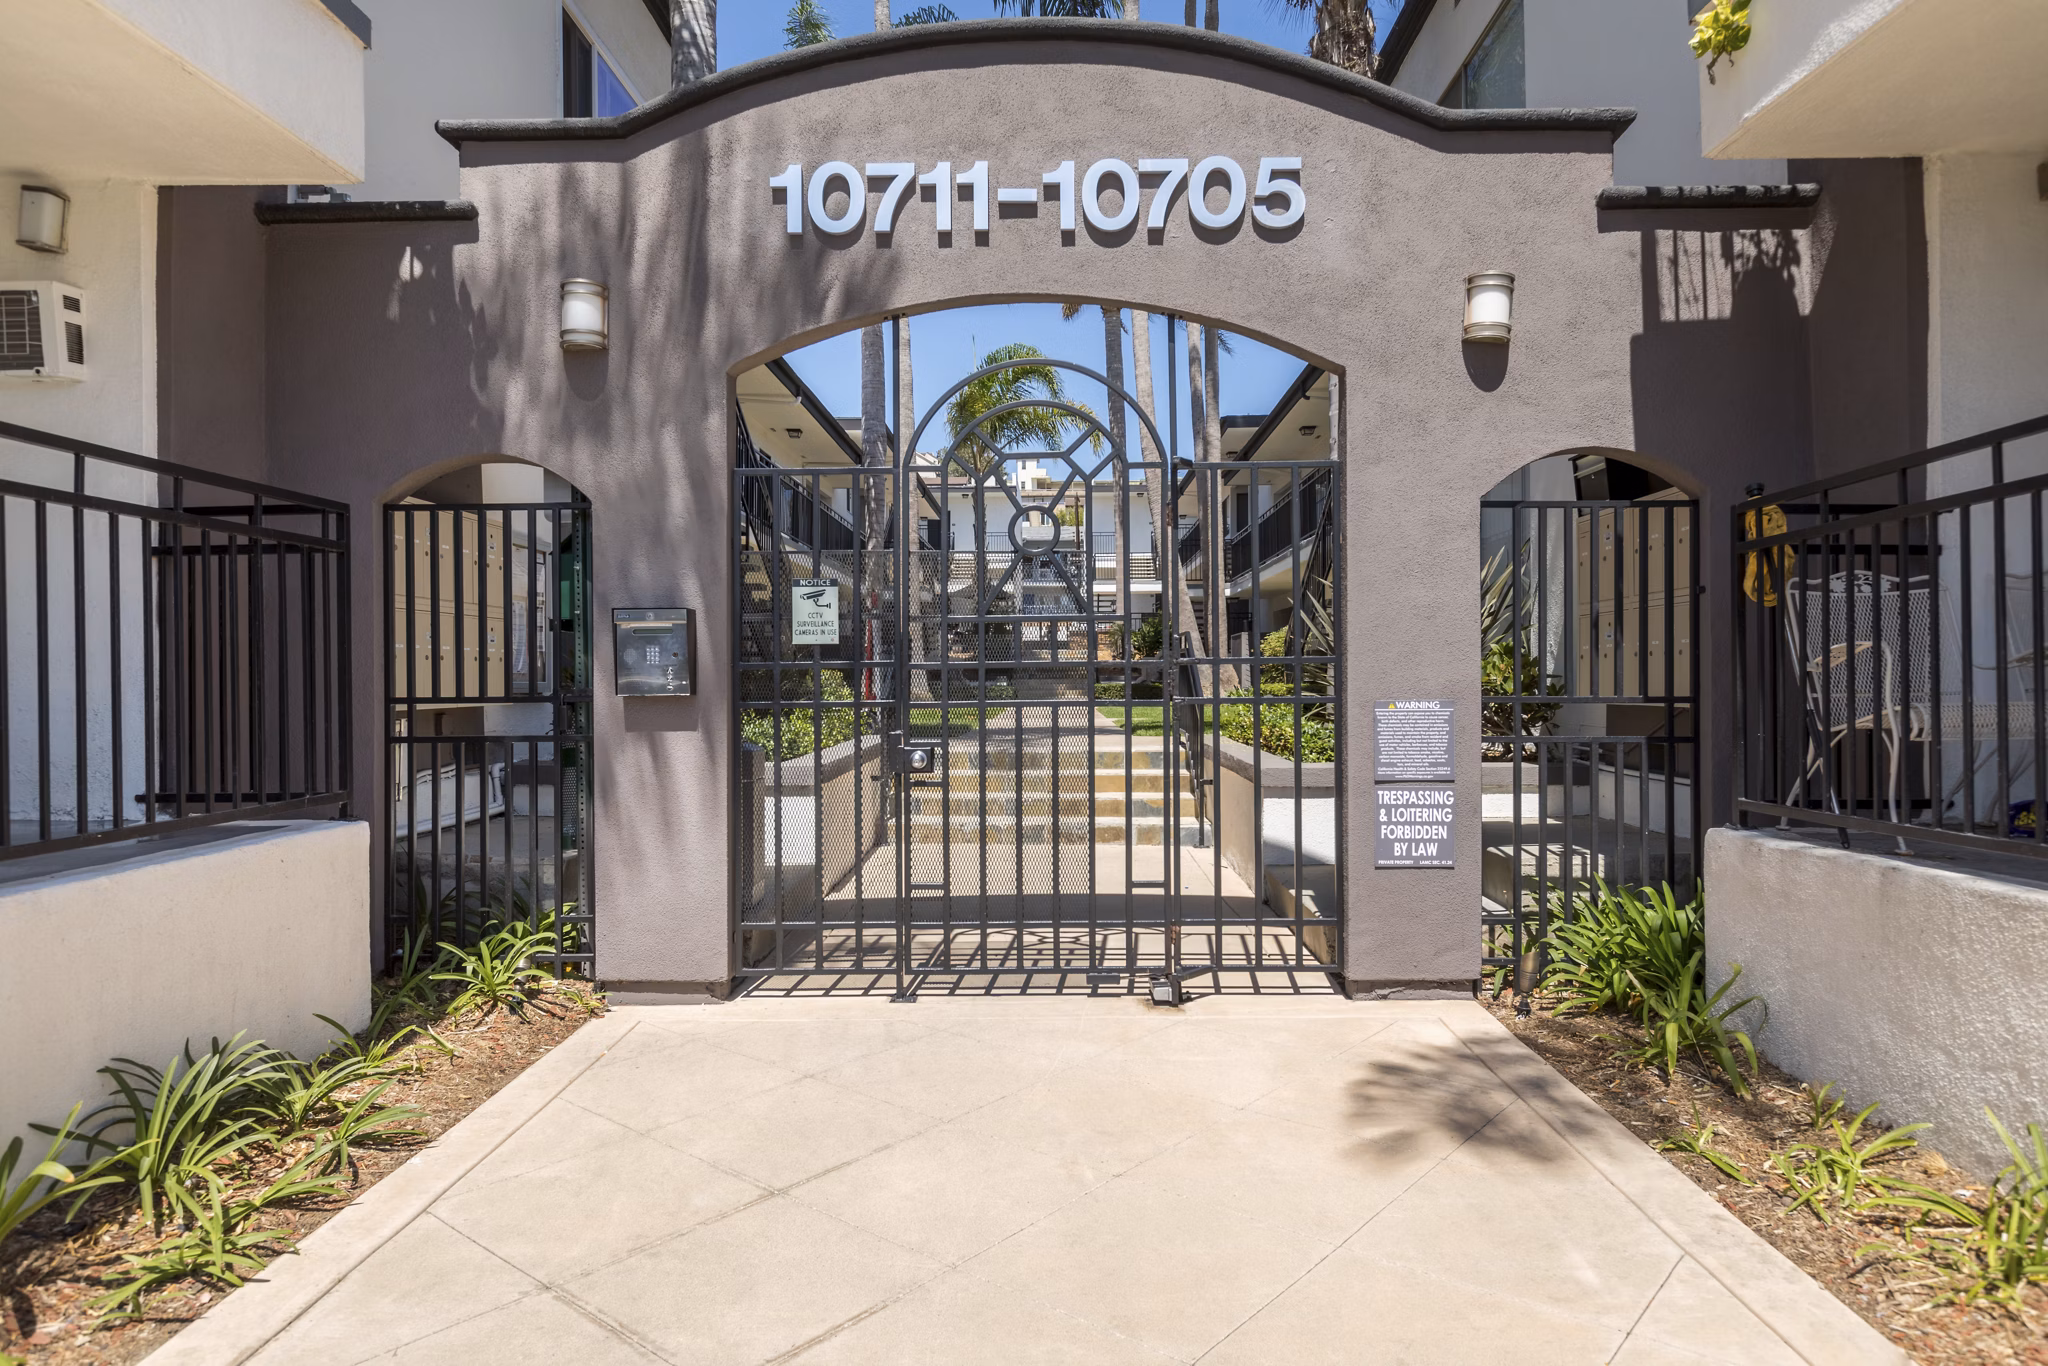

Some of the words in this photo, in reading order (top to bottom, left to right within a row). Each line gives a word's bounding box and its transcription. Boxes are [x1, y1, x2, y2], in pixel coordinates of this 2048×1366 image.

[769, 155, 1306, 235] 10711-10705
[796, 620, 835, 628] SURVEILLANCE
[1395, 700, 1441, 709] WARNING
[1377, 790, 1455, 805] TRESPASSING
[1379, 808, 1388, 822] &
[1391, 807, 1453, 822] LOITERING
[1381, 824, 1448, 839] FORBIDDEN
[1394, 842, 1408, 857] BY
[1411, 842, 1438, 857] LAW
